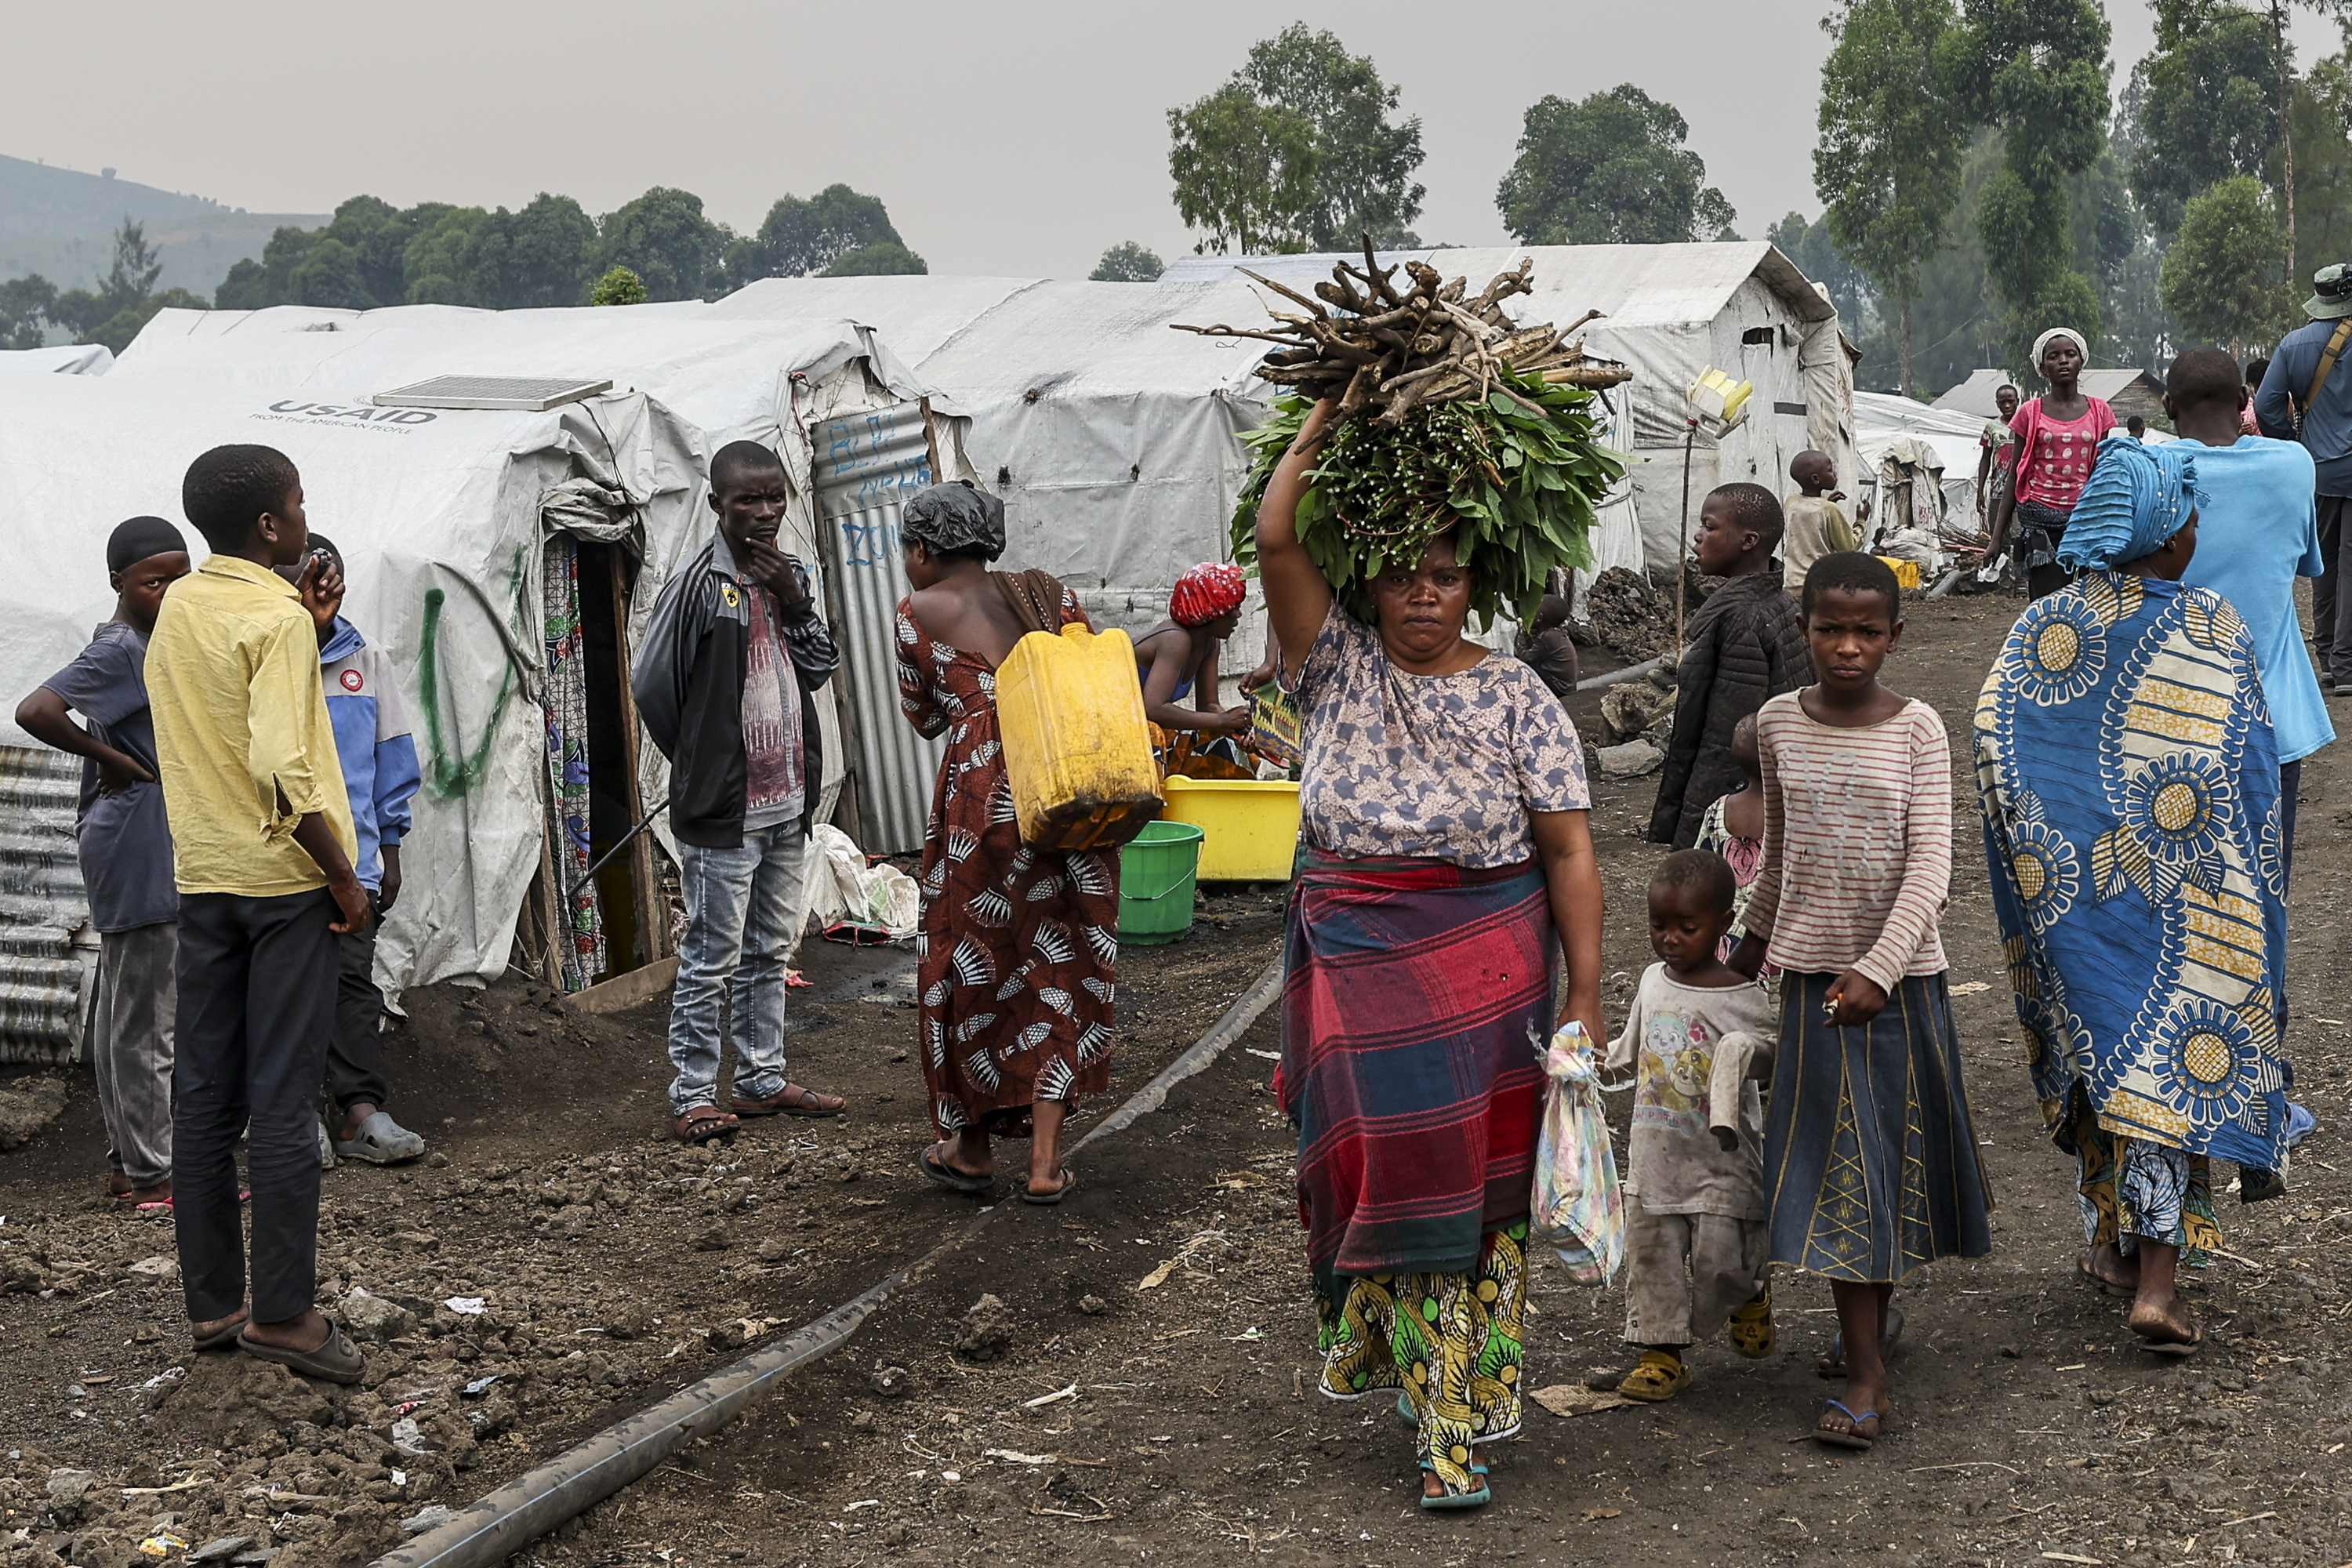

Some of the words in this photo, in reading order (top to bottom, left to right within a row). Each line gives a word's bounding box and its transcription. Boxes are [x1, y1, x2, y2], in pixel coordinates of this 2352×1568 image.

[269, 400, 437, 424] USAID
[307, 419, 369, 430] AMERICAN
[370, 425, 413, 434] PEOPLE
